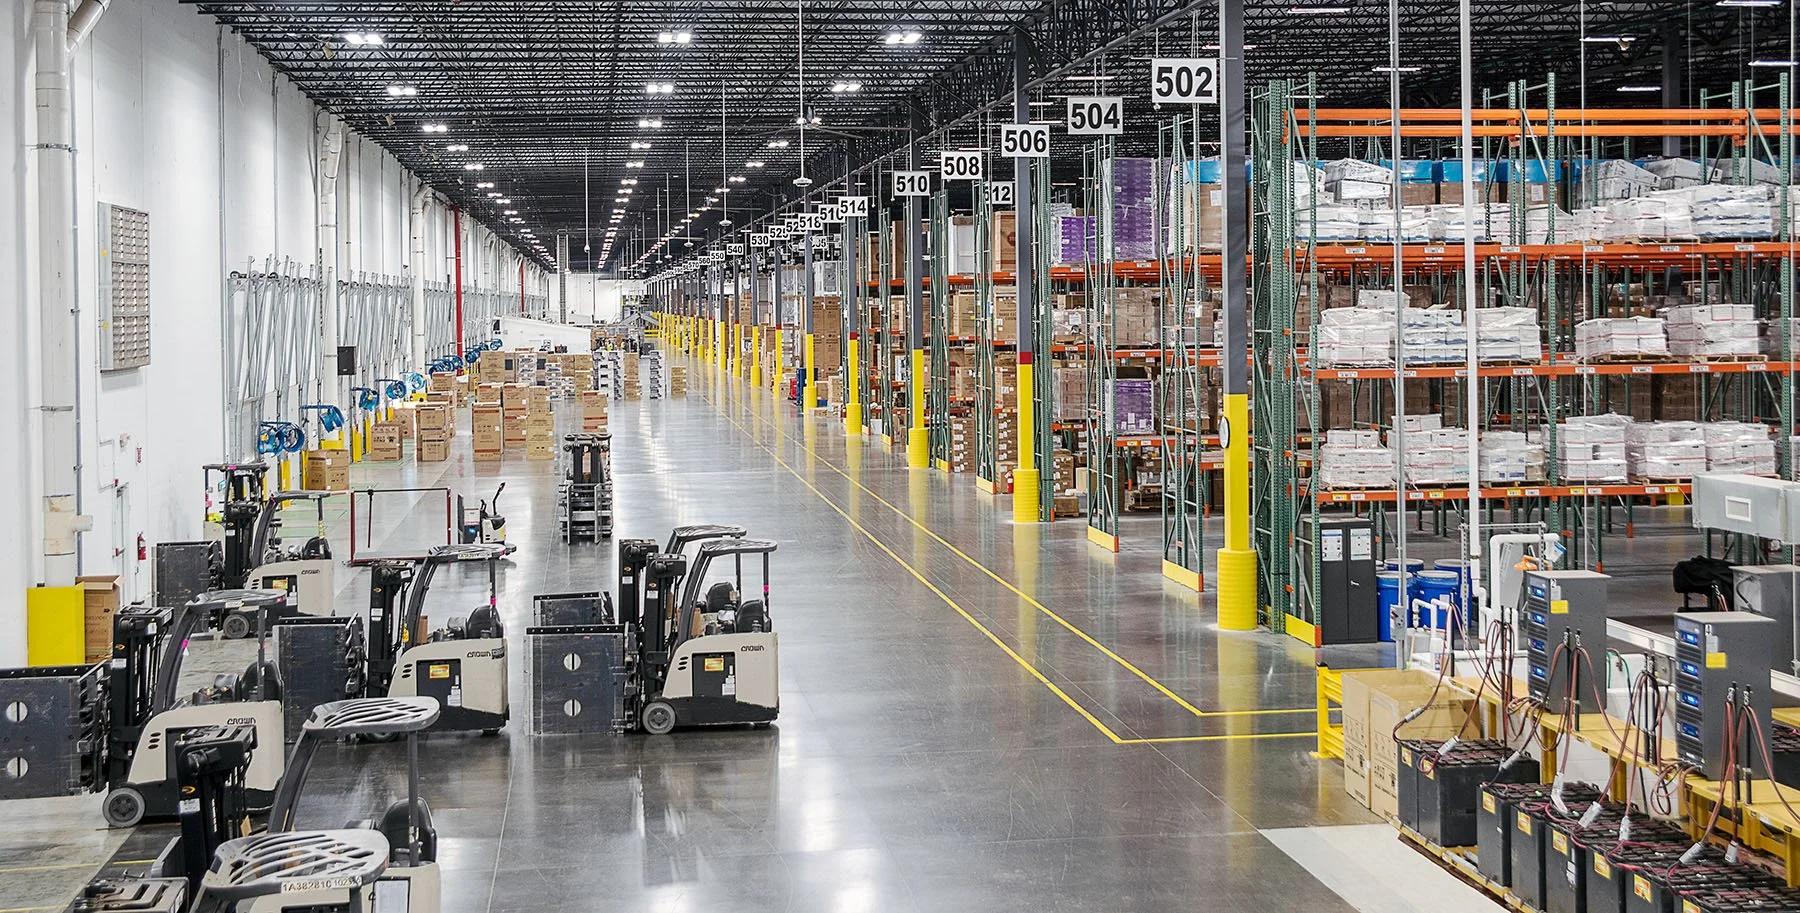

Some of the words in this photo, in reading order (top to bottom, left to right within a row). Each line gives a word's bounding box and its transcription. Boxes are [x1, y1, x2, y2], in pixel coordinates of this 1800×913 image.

[1155, 66, 1213, 97] 502
[1070, 103, 1120, 130] 504
[1004, 130, 1047, 153] 506
[943, 156, 980, 176] 508
[896, 175, 928, 193] 510
[840, 200, 866, 214] 514
[786, 221, 806, 233] 52
[799, 216, 821, 228] 518
[751, 235, 769, 246] 530
[727, 245, 743, 254] 540
[698, 257, 711, 265] 560
[711, 252, 725, 260] 550
[227, 717, 256, 725] CROWN
